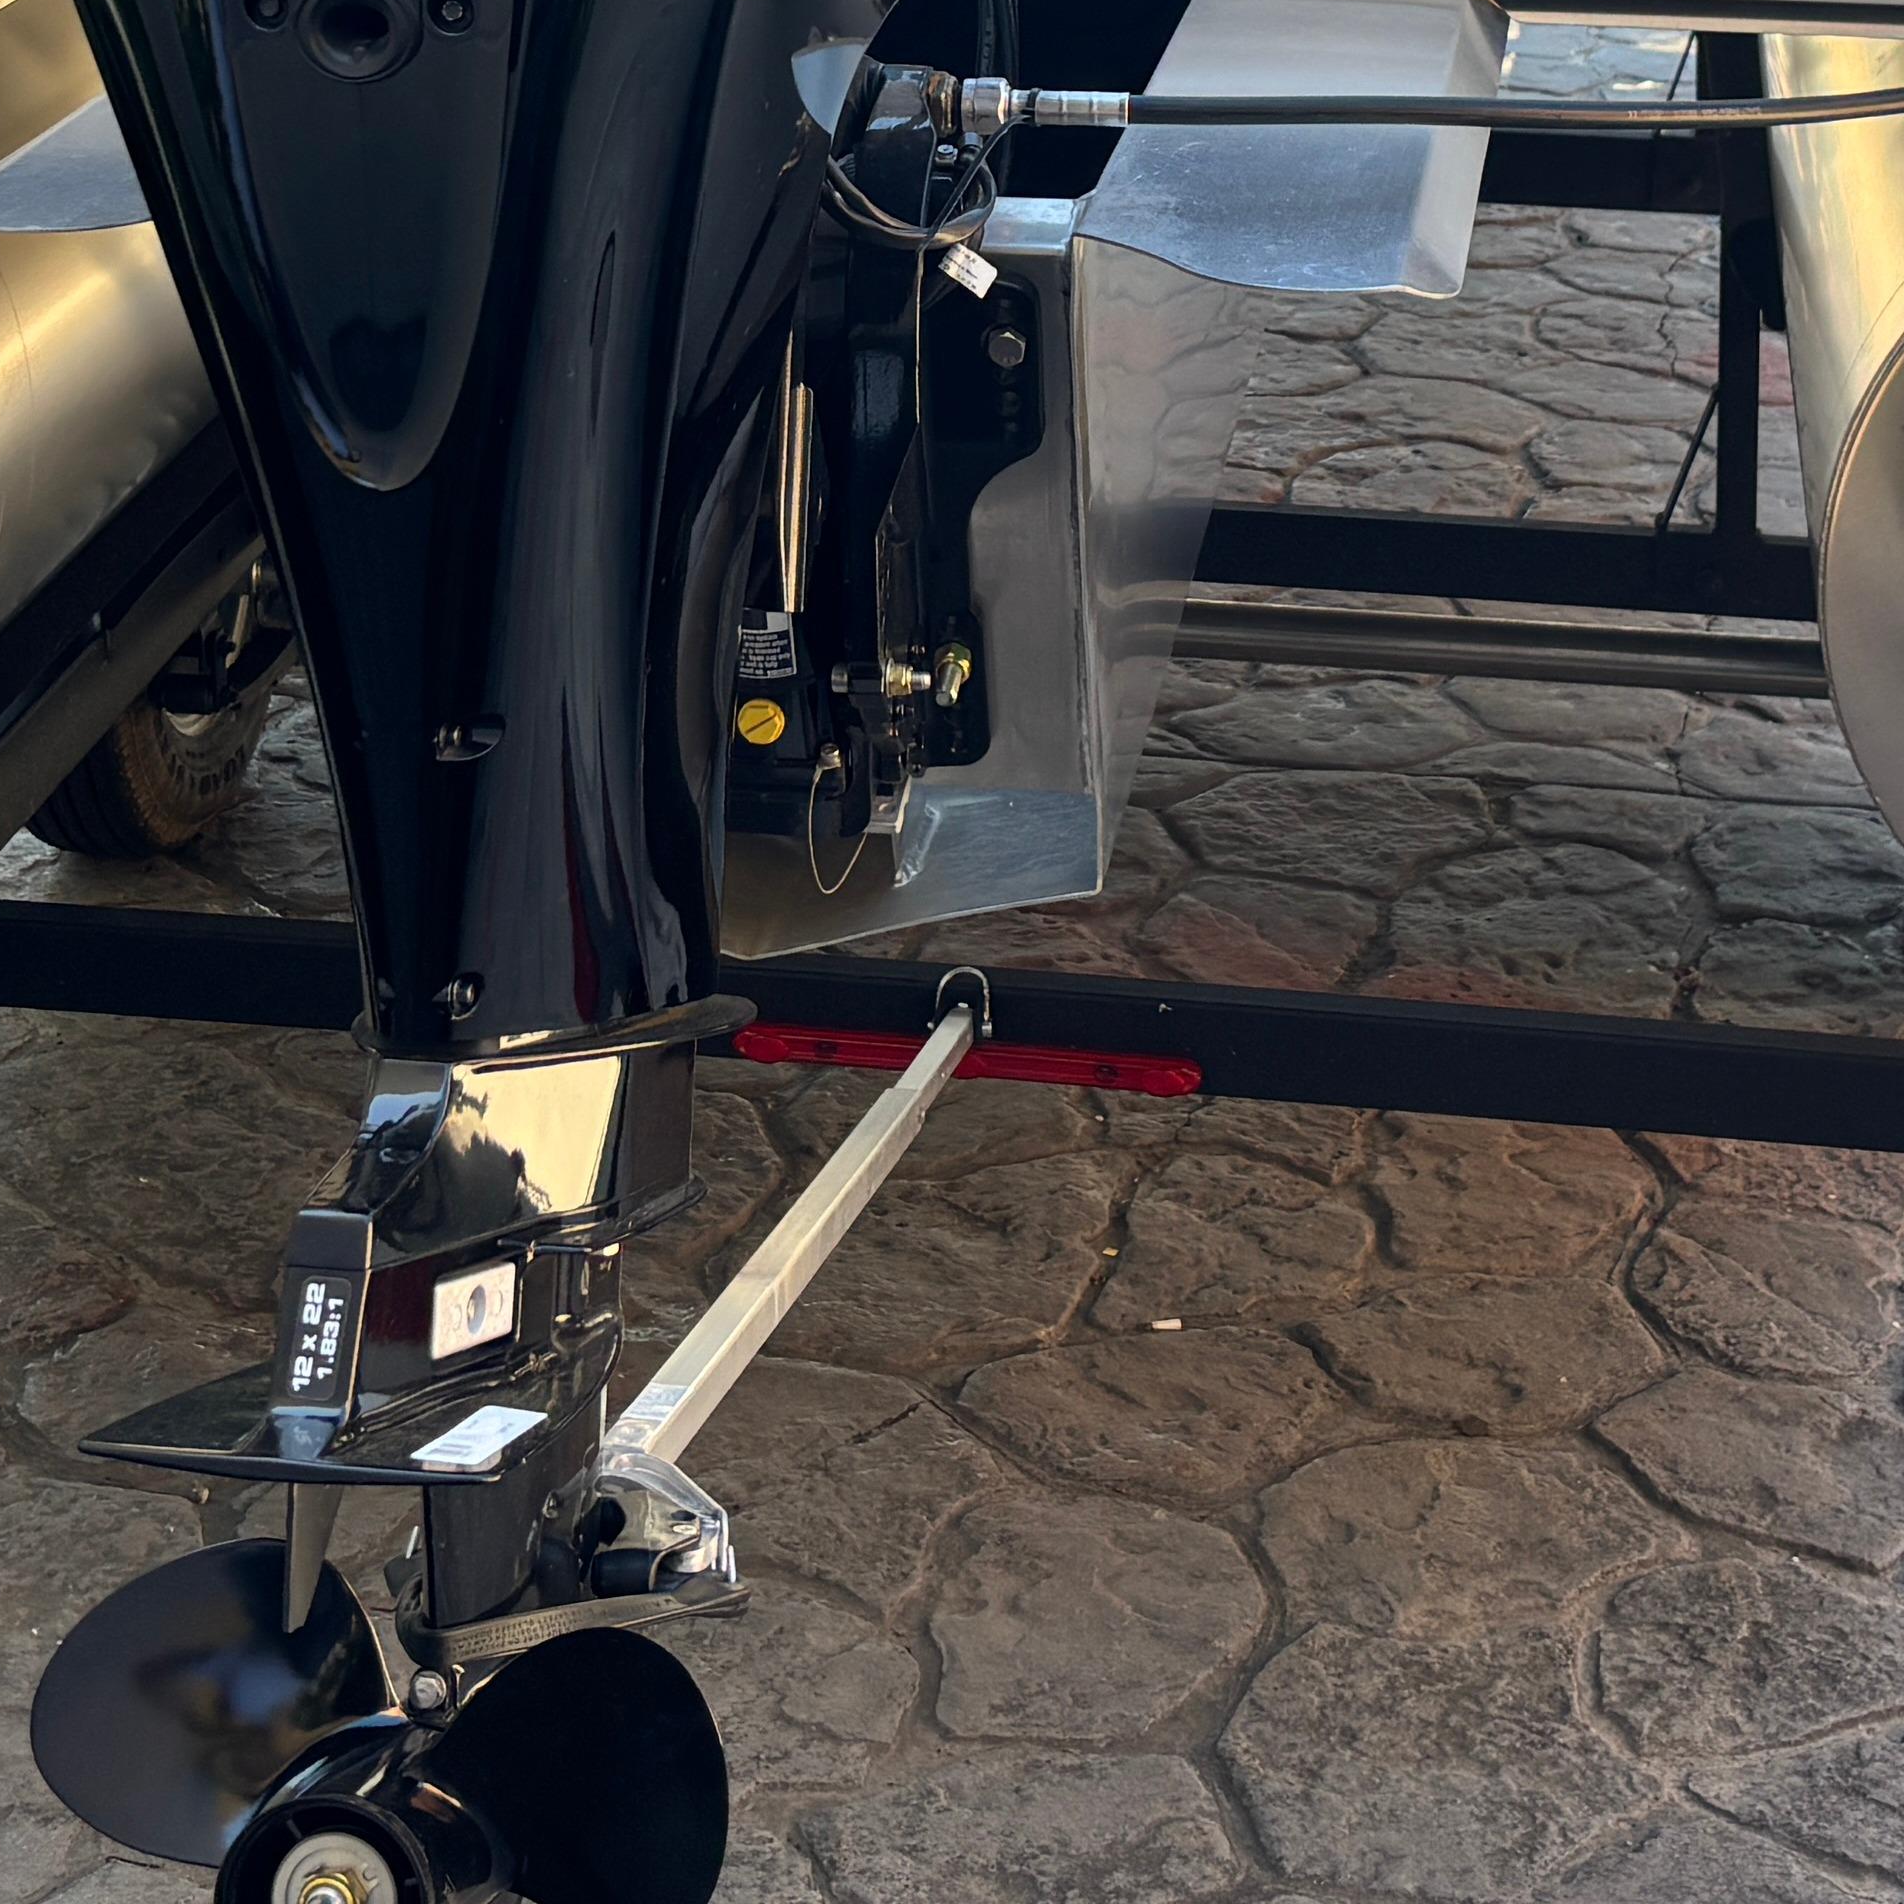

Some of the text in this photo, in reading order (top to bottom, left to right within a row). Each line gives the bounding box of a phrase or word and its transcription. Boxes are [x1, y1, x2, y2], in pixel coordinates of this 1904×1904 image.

[291, 1282, 326, 1392] 12 x 22
[316, 1297, 344, 1380] 1.83:1
